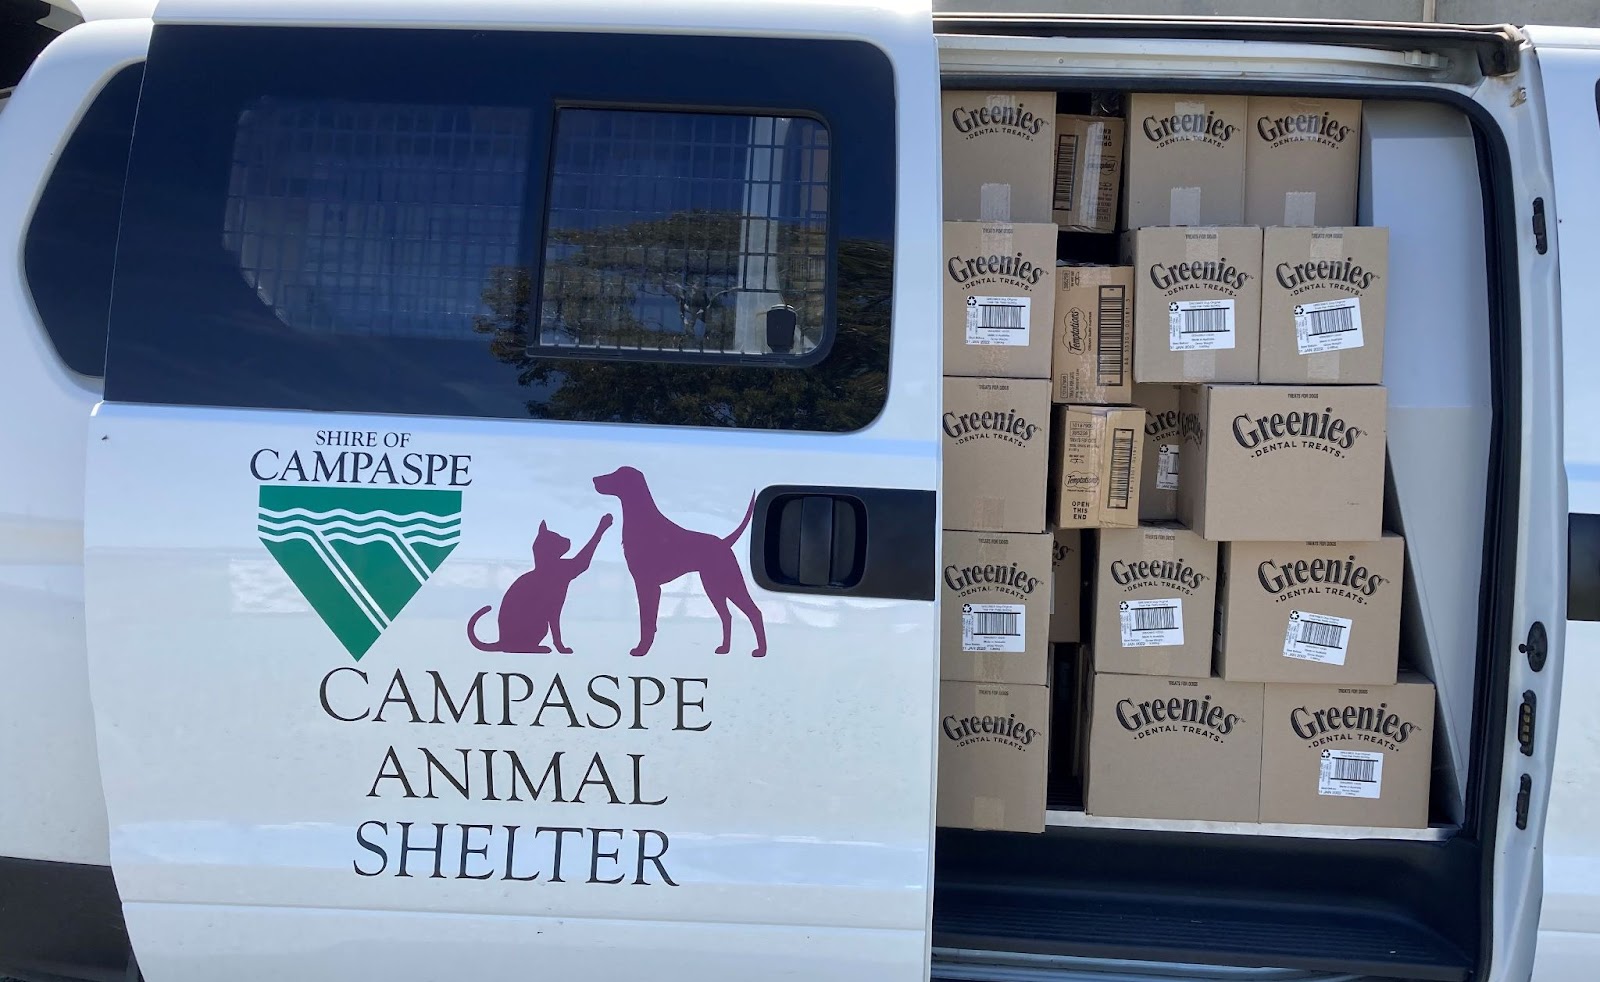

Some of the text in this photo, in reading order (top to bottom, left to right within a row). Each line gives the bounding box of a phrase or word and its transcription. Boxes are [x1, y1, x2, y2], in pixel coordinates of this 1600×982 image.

[952, 103, 1045, 135] Greenies
[969, 127, 1031, 141] DENTAL TREATS
[1142, 110, 1236, 142] Greenies
[1257, 111, 1351, 143] Greenies
[1159, 136, 1222, 148] DENTAL TREATS
[1273, 136, 1336, 149] DENTAL TREATS
[948, 252, 1043, 286] Greenies
[965, 277, 1030, 291] DENTAL TREATS
[1149, 257, 1249, 292] Greenies
[1275, 257, 1374, 292] Greenies
[1167, 283, 1234, 296] DENTAL TREATS
[1293, 282, 1360, 296] DENTAL TREATS
[1068, 310, 1083, 352] Temptations
[315, 430, 412, 449] SHIRE OF
[942, 409, 1037, 443] Greenies
[959, 433, 1023, 447] DENTAL TREATS
[1231, 407, 1362, 450] Greenies
[1255, 440, 1341, 458] DENTAL TREATS
[249, 447, 473, 488] CAMPASPE
[944, 562, 1039, 595] Greenies
[1110, 558, 1205, 592] Greenies
[1127, 581, 1191, 595] DENTAL TREATS
[1257, 555, 1385, 598] Greenies
[961, 586, 1025, 600] DENTAL TREATS
[1279, 587, 1364, 604] DENTAL TREATS
[318, 666, 713, 732] CAMPASPE
[1115, 694, 1239, 736] Greenies
[942, 713, 1037, 746] Greenies
[1137, 724, 1221, 743] DENTAL TREATS
[1290, 702, 1417, 745] Greenies
[960, 736, 1023, 751] DENTAL TREATS
[1312, 733, 1395, 752] DENTAL TREATS
[365, 745, 669, 806] ANIMAL
[352, 820, 681, 887] SHELTER
